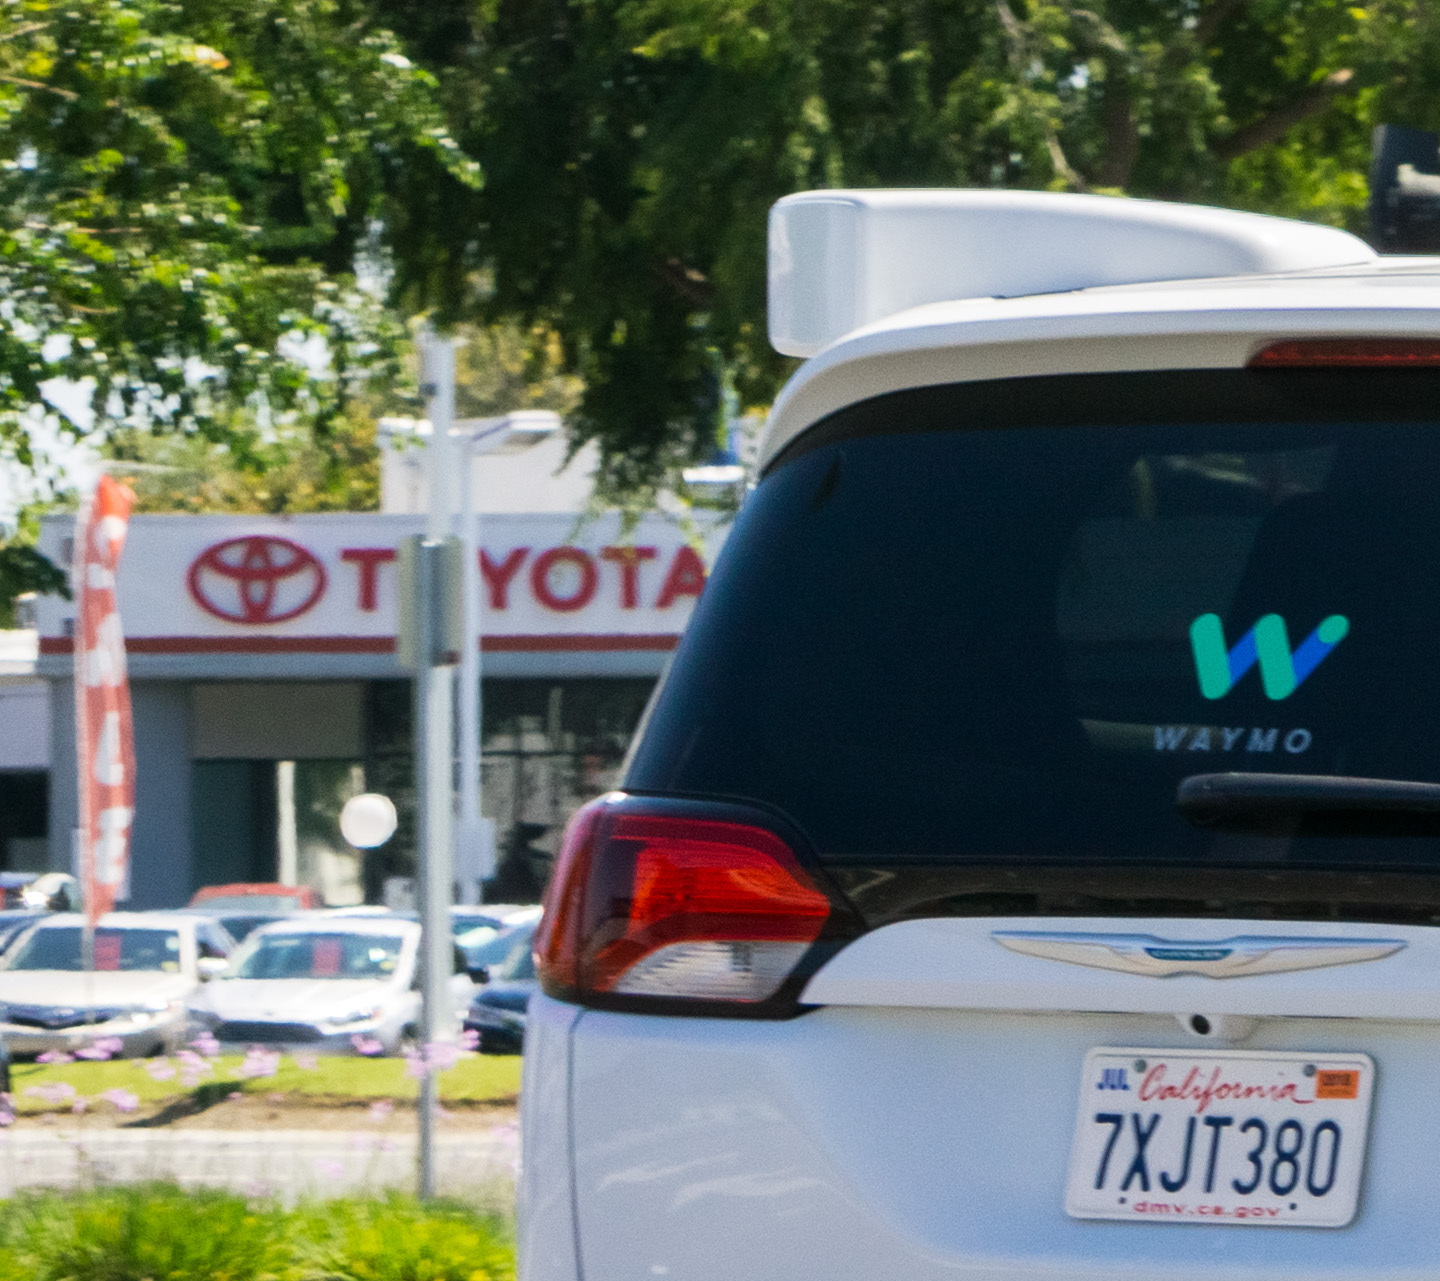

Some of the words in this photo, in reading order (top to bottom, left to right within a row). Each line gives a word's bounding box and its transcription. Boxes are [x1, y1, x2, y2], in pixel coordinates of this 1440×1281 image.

[340, 546, 708, 612] TYOTA
[1153, 726, 1313, 754] WAYMO
[1138, 1063, 1314, 1114] California
[1093, 1112, 1343, 1198] 7XJT380
[1132, 1200, 1282, 1219] dmv.ca.gov
